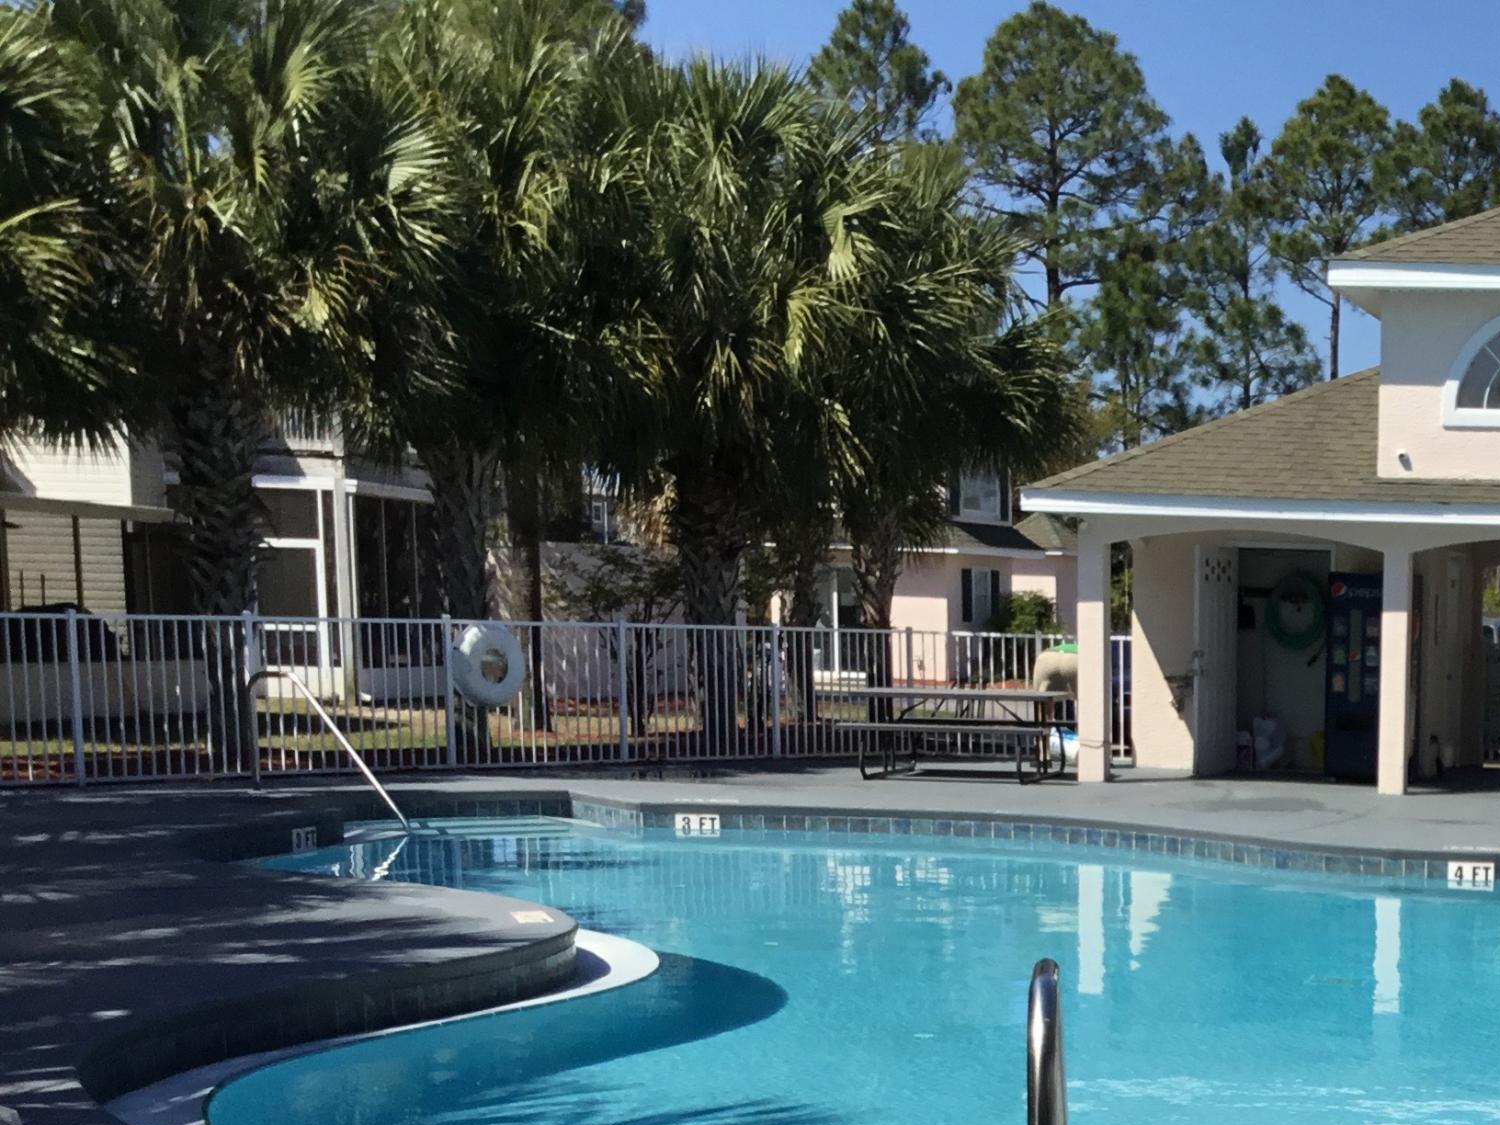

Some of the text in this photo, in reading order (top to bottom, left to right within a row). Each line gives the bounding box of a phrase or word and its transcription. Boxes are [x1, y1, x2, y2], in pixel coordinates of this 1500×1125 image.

[682, 816, 717, 836] 3 FT
[1454, 866, 1492, 888] 4 FT
